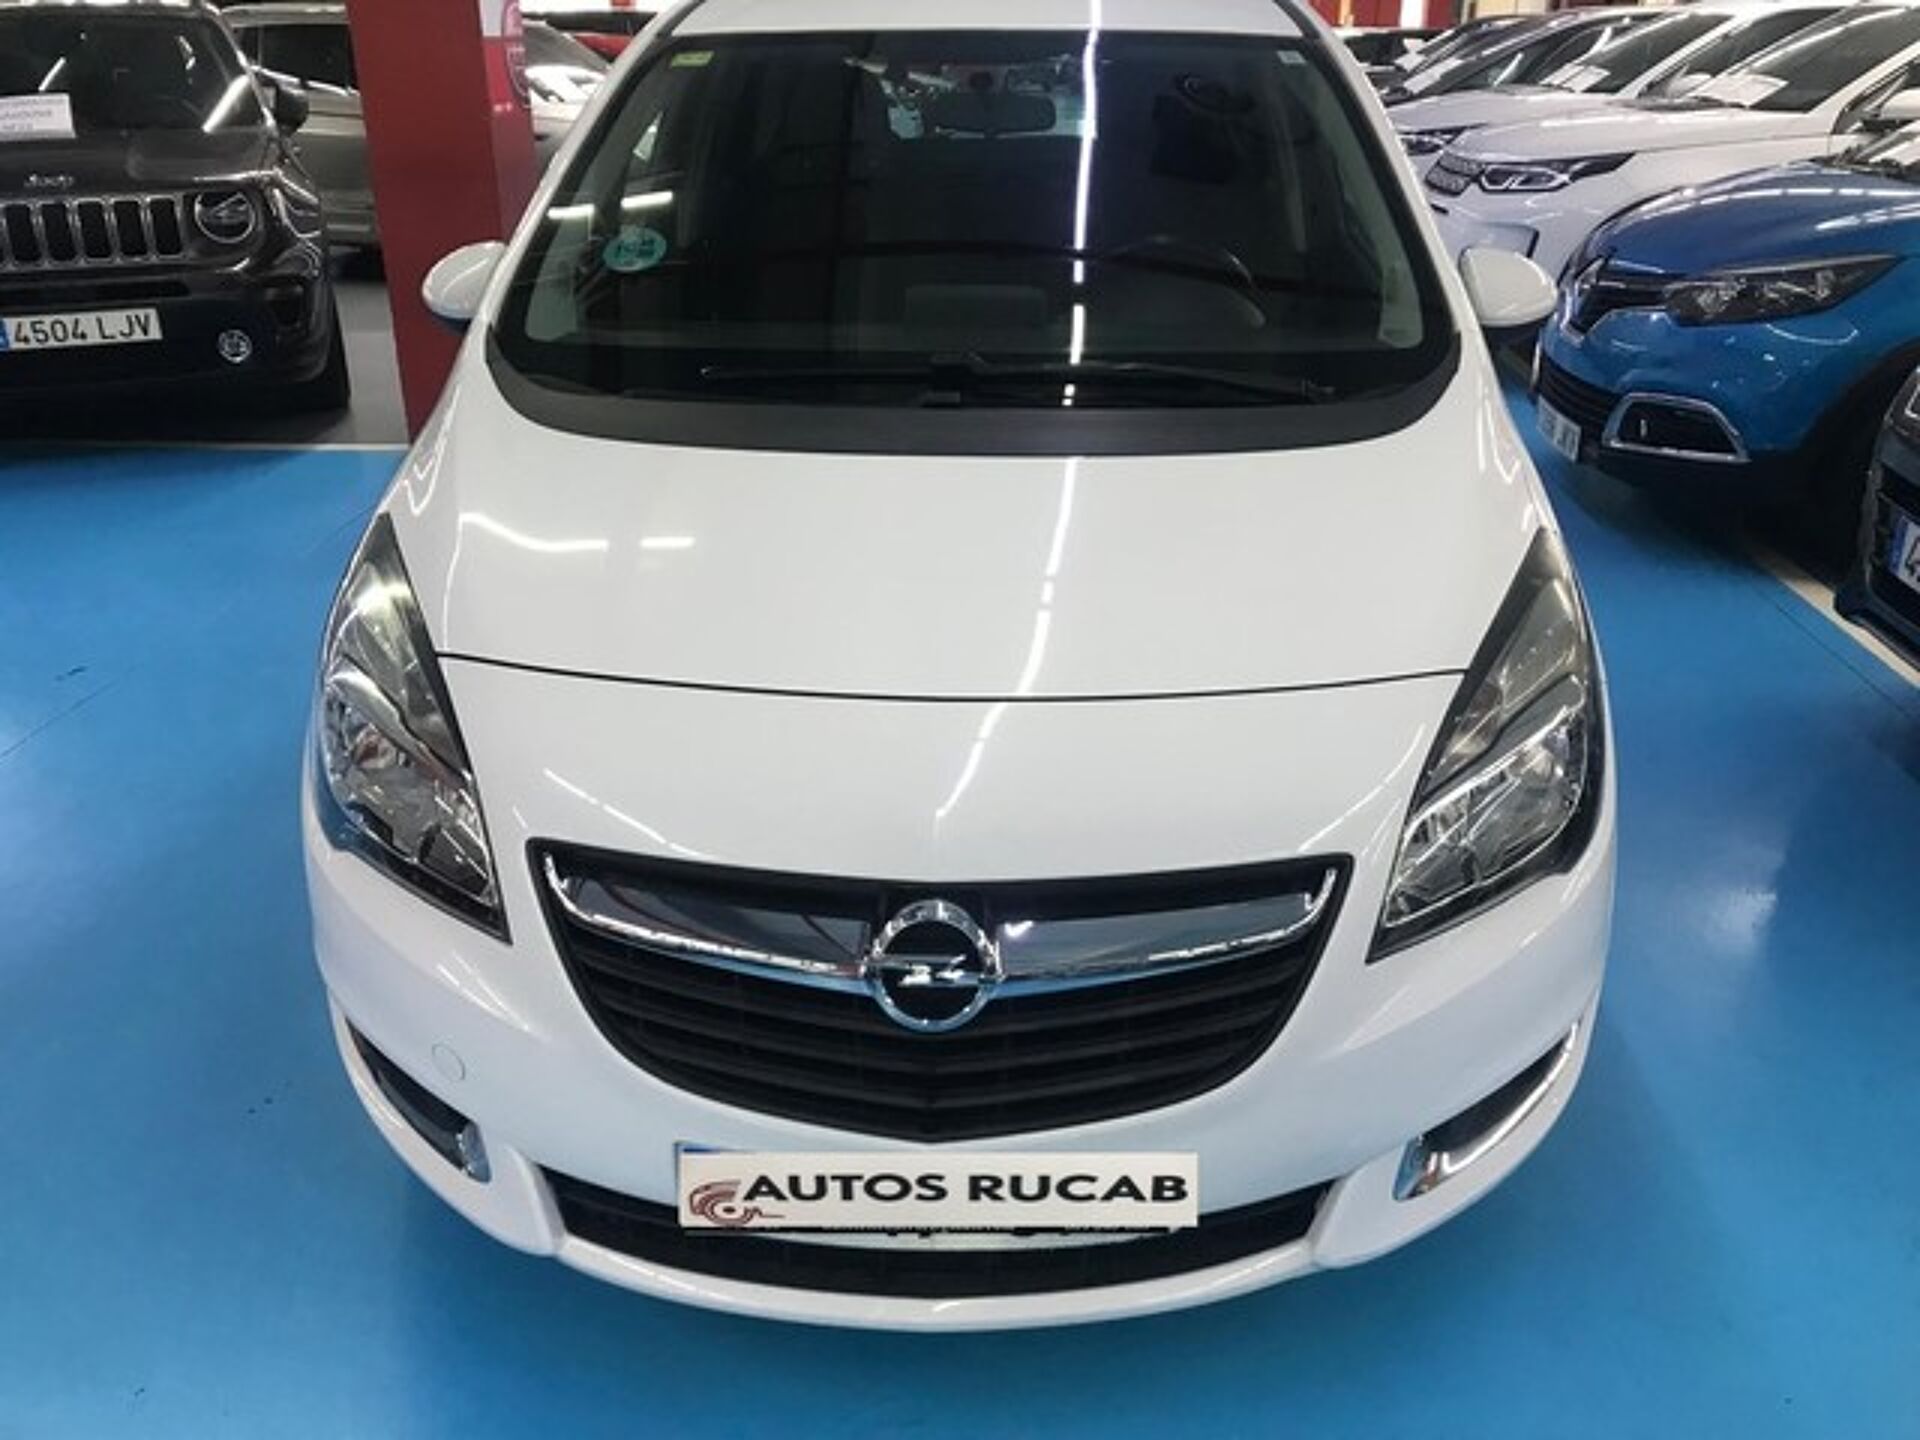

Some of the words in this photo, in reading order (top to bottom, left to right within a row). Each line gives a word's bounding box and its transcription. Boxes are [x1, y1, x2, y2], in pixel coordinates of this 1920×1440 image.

[15, 317, 87, 346] 4504
[95, 313, 150, 339] LJV
[743, 1174, 948, 1202] AUTOS
[968, 1174, 1188, 1202] RUCAB
